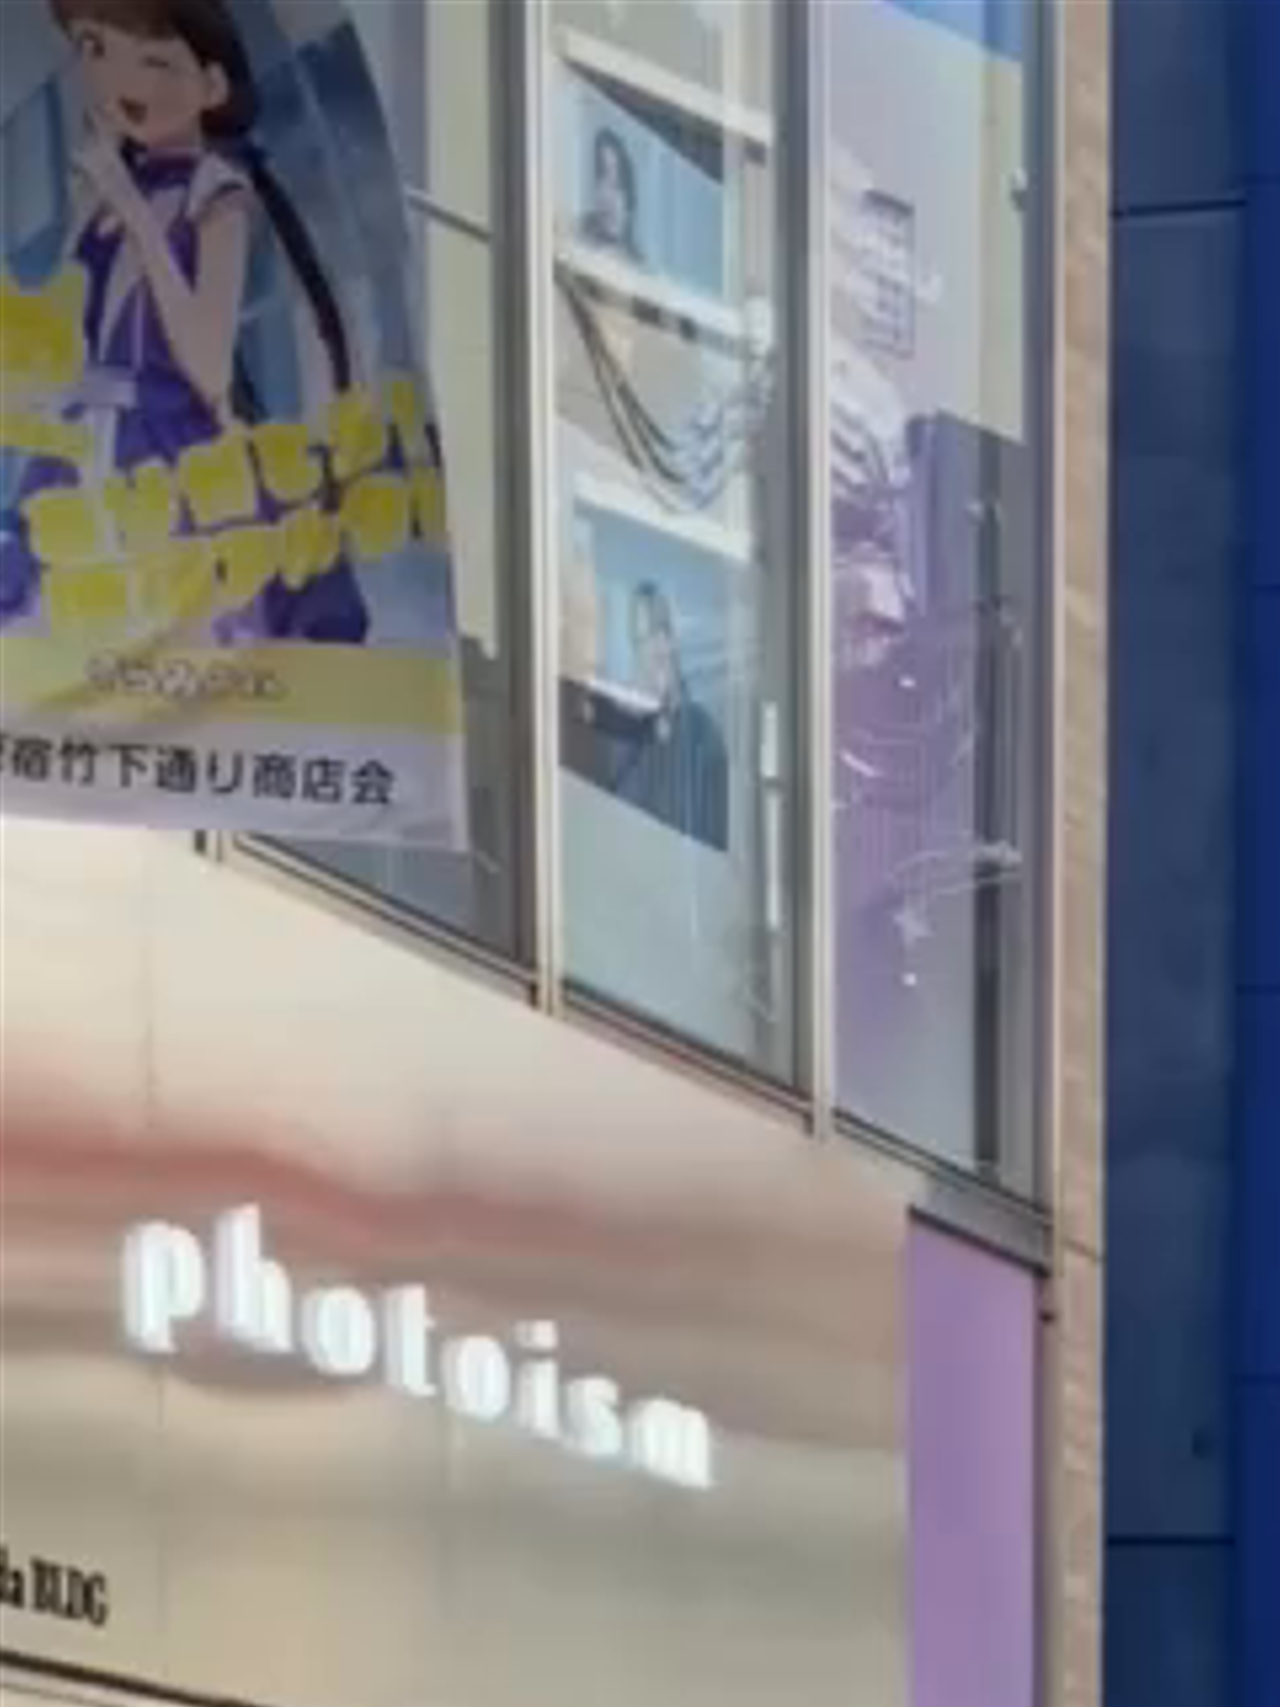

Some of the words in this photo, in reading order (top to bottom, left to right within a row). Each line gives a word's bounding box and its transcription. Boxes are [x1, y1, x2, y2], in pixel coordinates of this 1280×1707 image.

[0, 737, 396, 807] 宿竹下通り商店会
[122, 1203, 713, 1490] photoism
